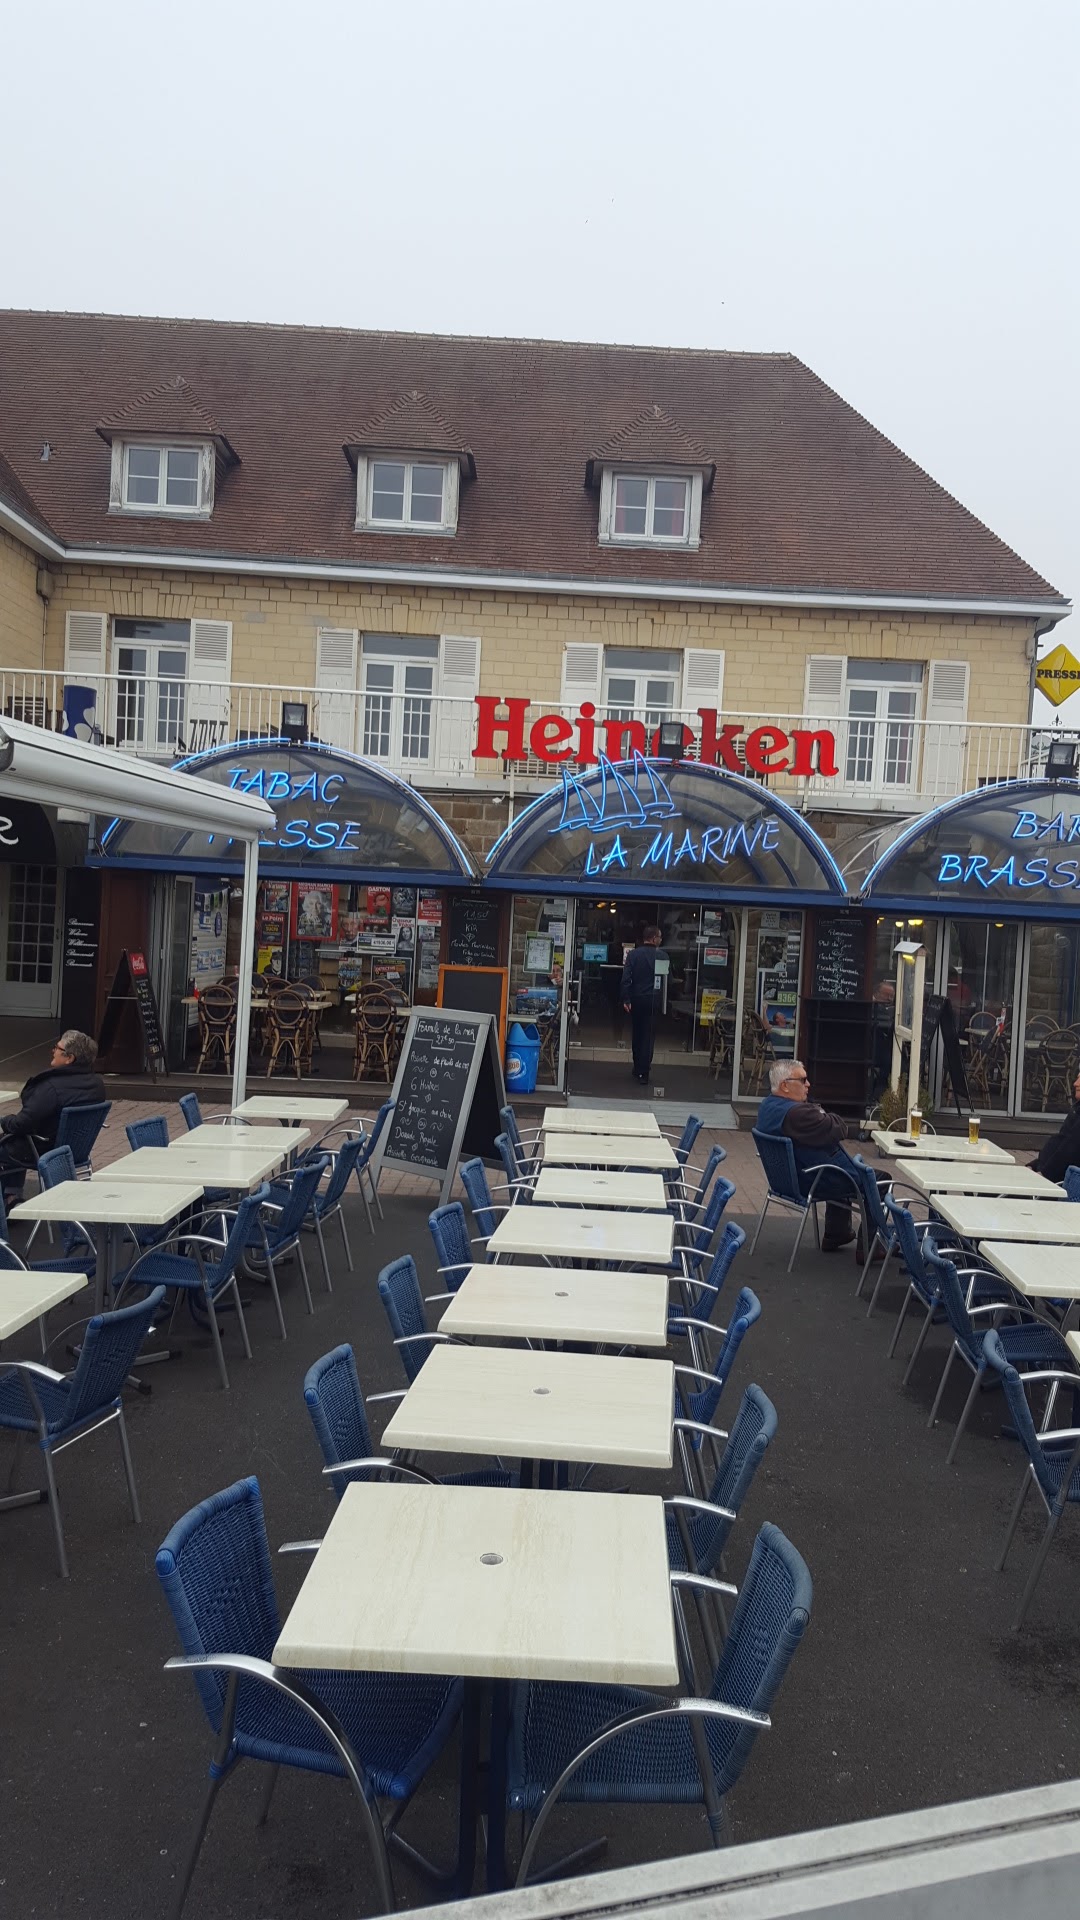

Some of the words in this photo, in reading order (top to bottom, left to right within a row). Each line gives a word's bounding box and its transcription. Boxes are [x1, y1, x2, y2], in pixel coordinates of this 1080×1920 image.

[1036, 669, 1080, 680] PRESS
[227, 768, 347, 804] TABAC
[585, 833, 628, 878] LA
[640, 820, 781, 870] MARINE
[937, 854, 1080, 889] BRASS
[410, 1076, 418, 1091] 6
